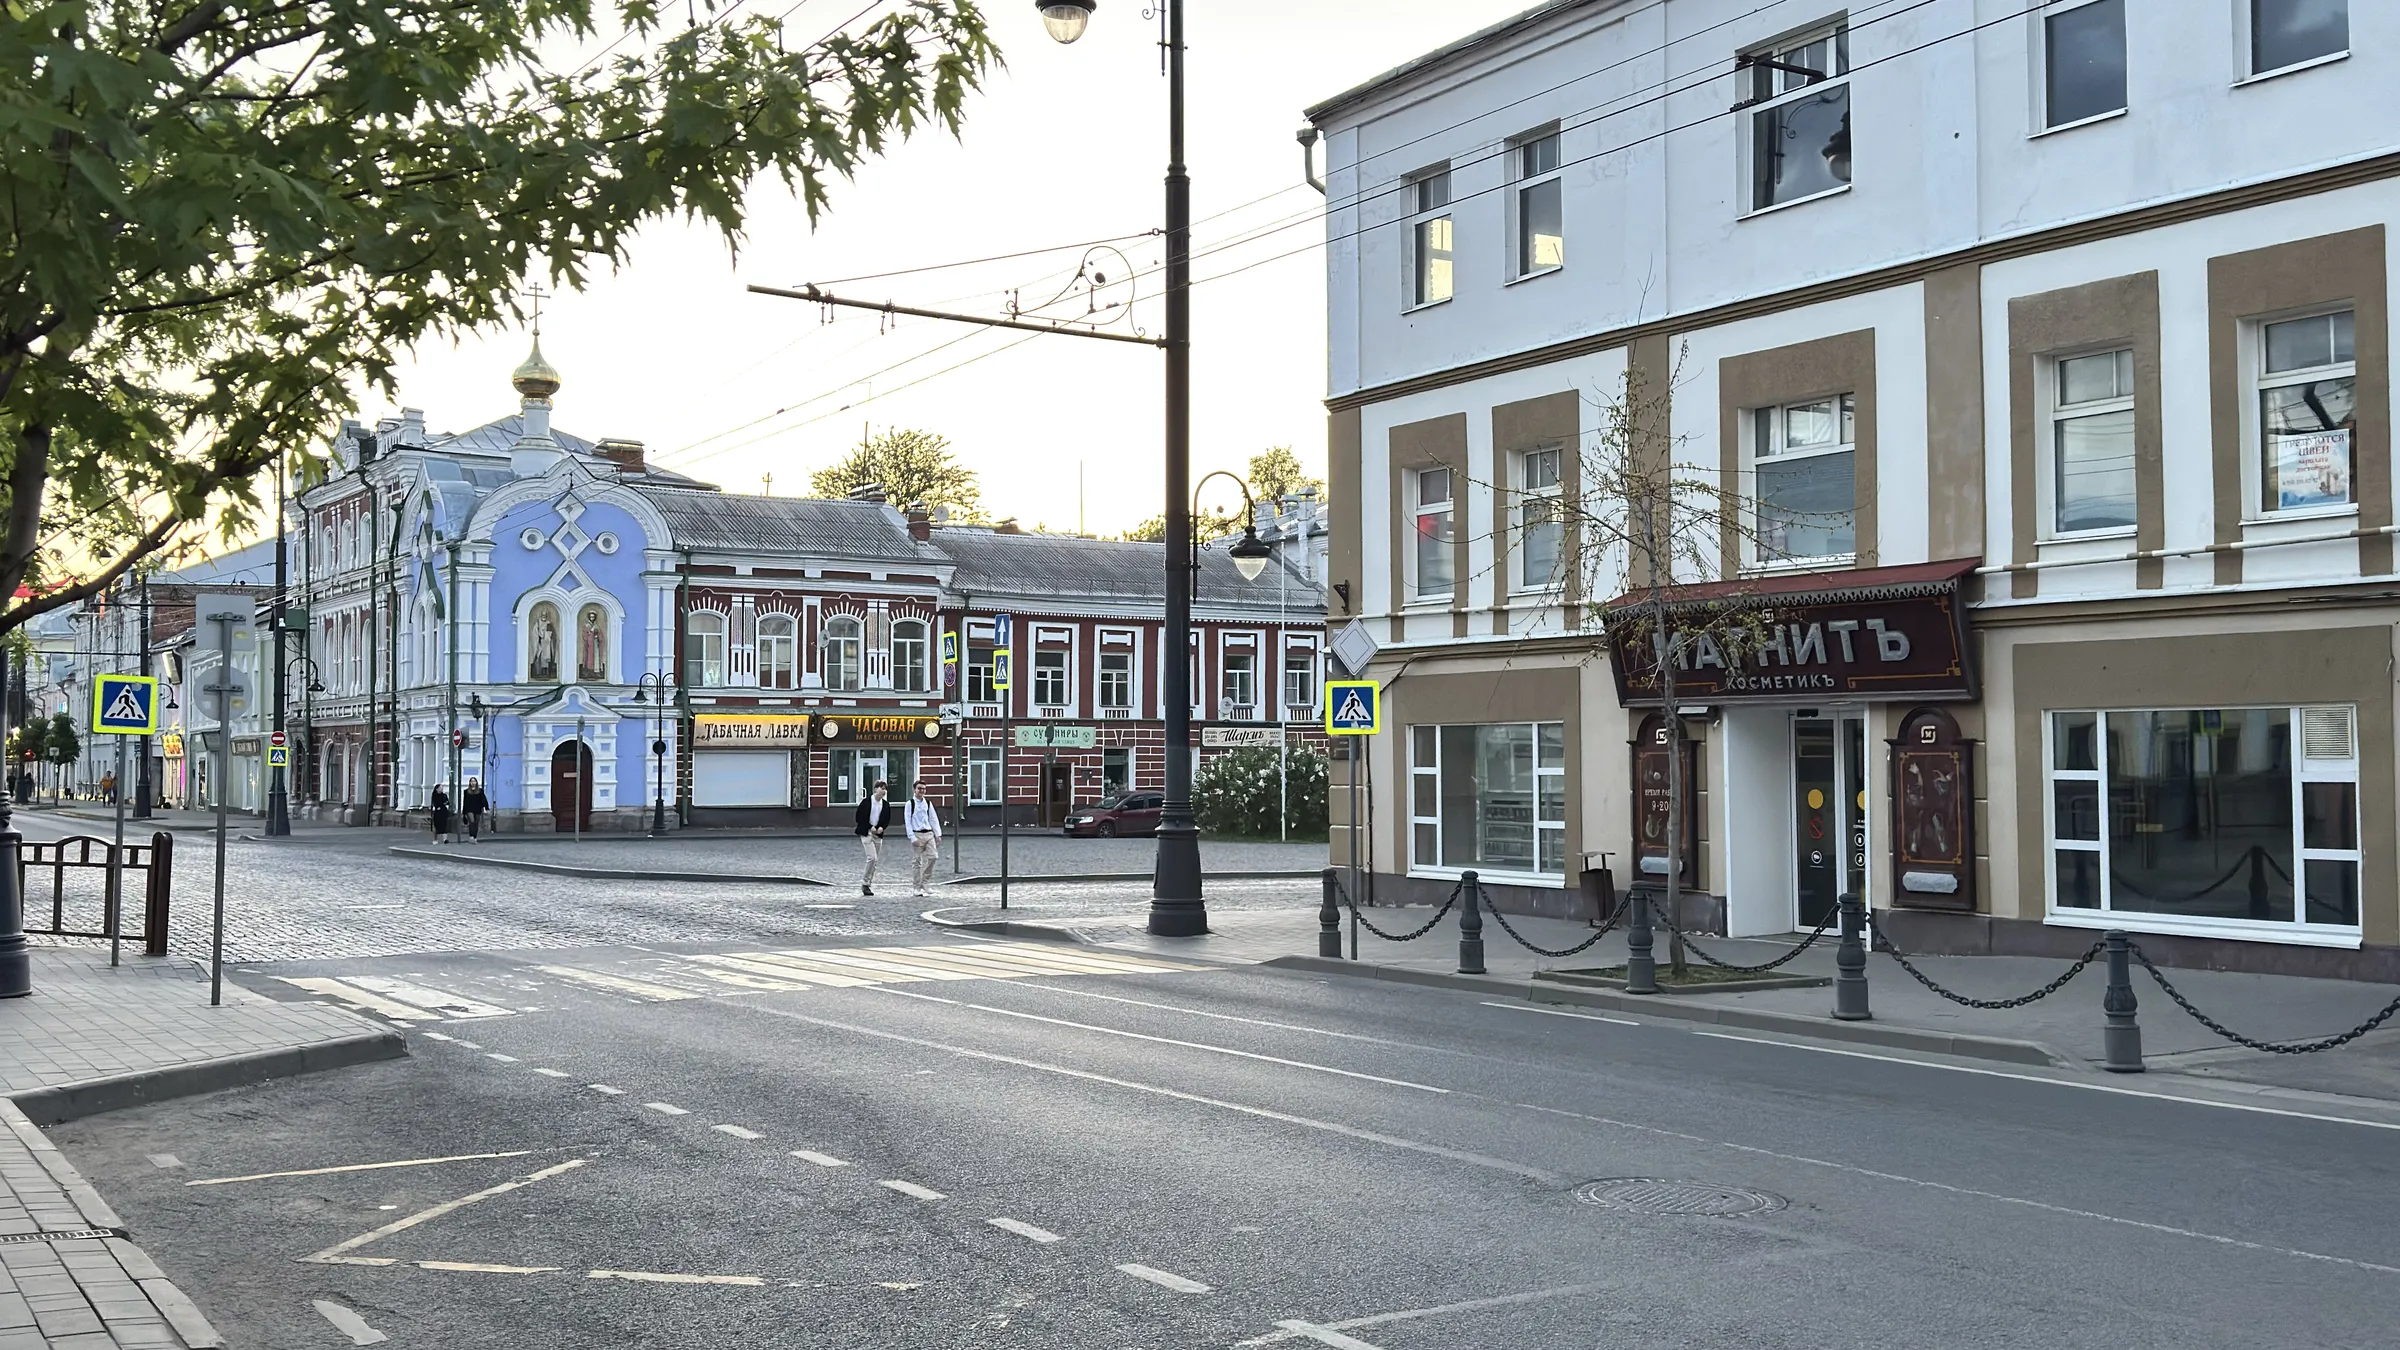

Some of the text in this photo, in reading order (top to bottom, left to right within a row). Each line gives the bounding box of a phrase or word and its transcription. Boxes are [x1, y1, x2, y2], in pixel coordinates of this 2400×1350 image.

[2285, 434, 2344, 448] ТРЕБУЮТСЯ
[1726, 674, 1834, 690] КОСМЕТИКЪ
[702, 723, 804, 741] ТАБАЧНАЯ ЛАВКА
[852, 718, 916, 733] ЧАСОВАЯ
[1033, 729, 1079, 739] СУНИРЫ
